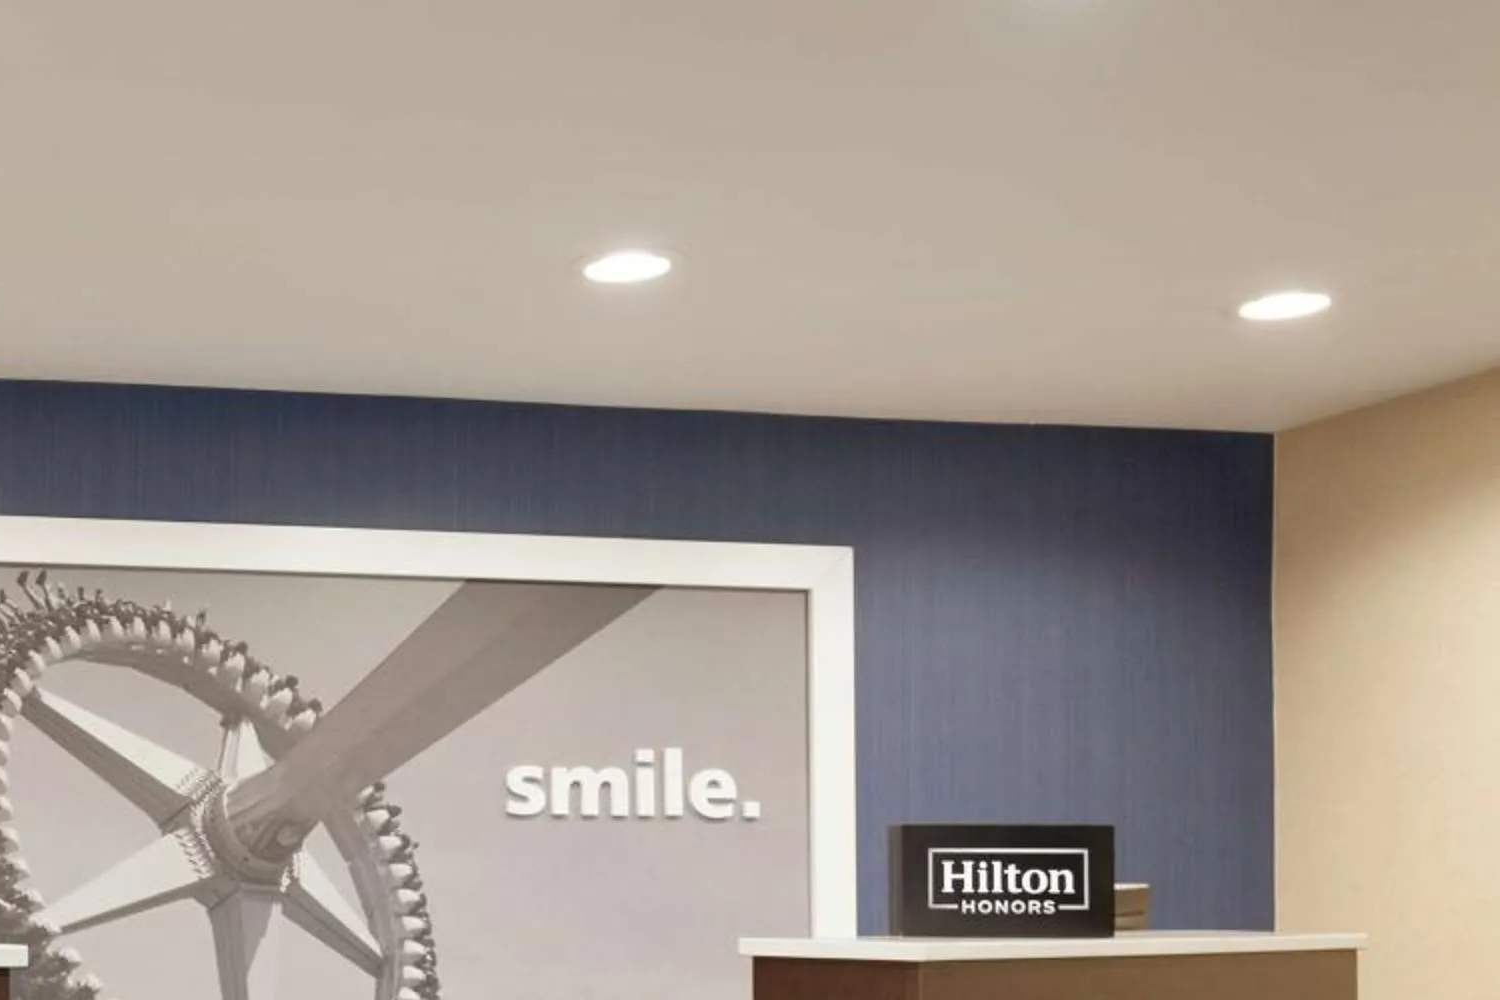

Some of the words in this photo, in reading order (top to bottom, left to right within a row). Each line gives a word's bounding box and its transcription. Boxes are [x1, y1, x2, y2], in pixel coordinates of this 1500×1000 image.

[504, 747, 761, 819] smile.
[941, 859, 1075, 894] Hilton
[961, 899, 1056, 915] HONORS
